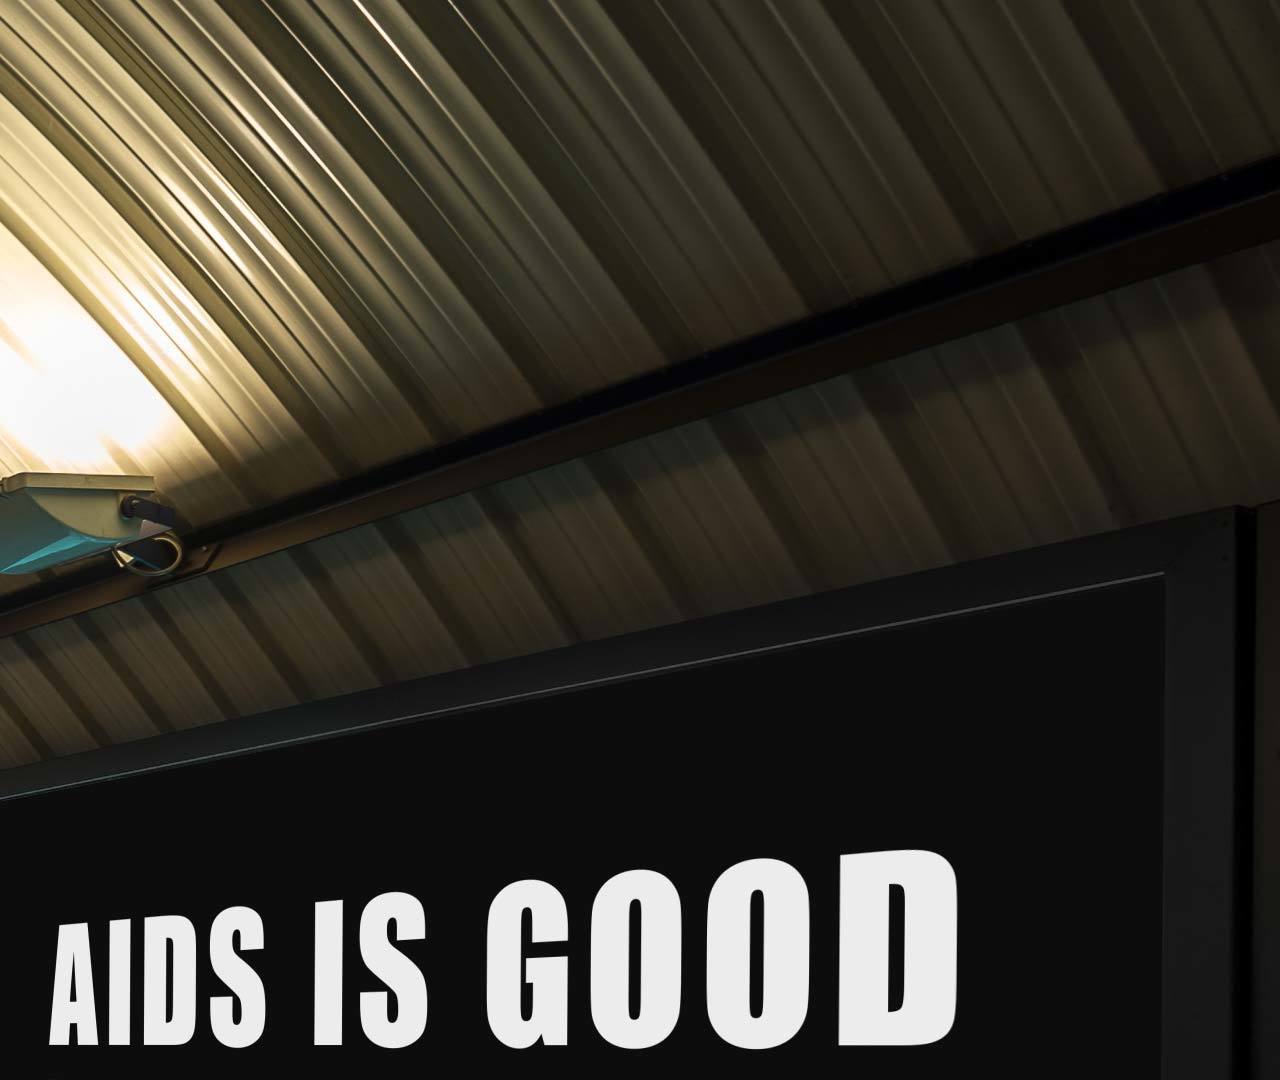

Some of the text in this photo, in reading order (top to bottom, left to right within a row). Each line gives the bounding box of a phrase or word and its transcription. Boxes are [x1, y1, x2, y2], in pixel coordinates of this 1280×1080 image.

[49, 850, 957, 1049] AIDS IS GOOD
